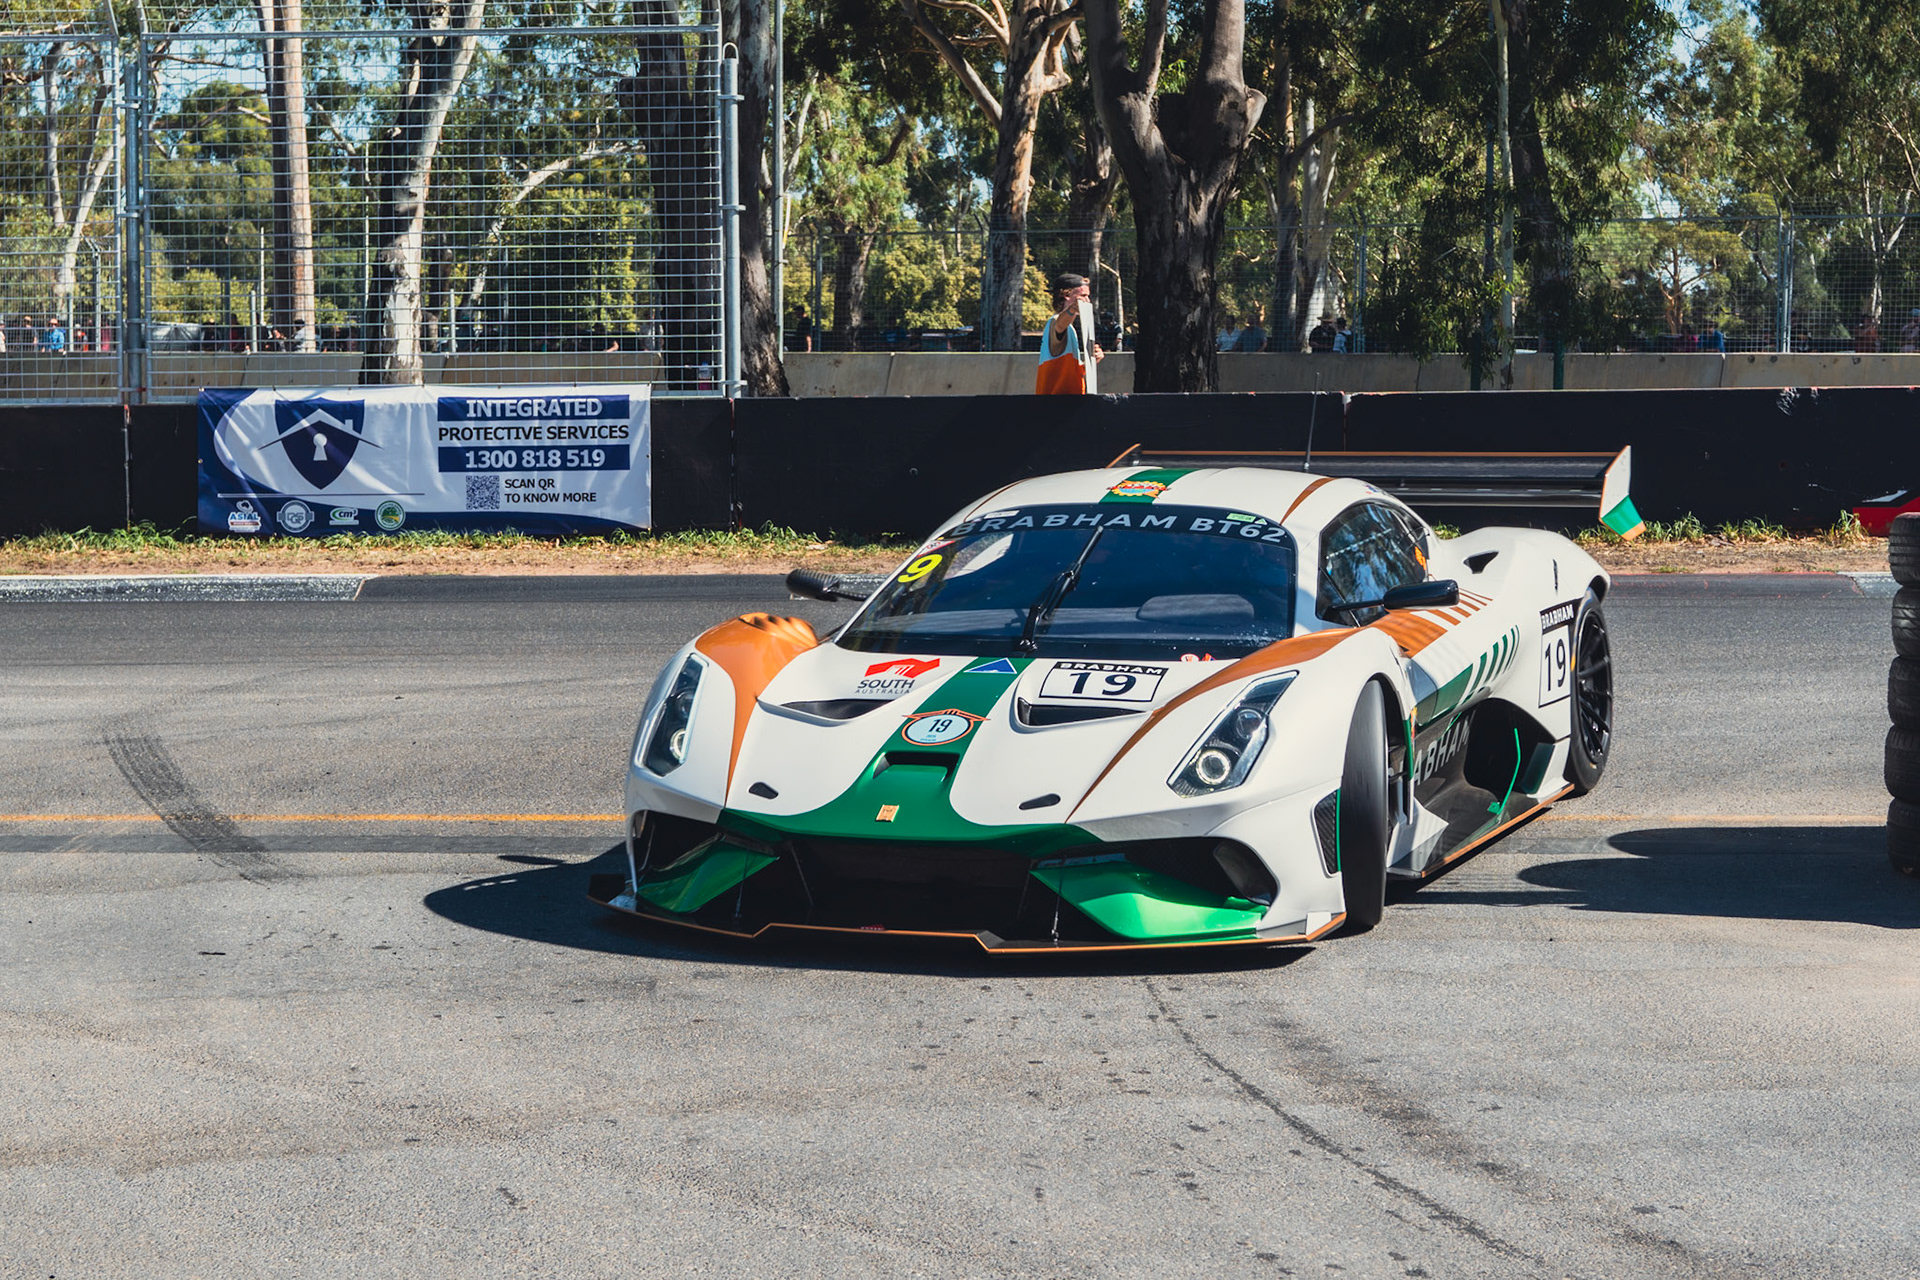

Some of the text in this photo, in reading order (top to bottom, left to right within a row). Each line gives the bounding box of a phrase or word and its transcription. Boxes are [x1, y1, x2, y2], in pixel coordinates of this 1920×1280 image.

[466, 398, 603, 418] INTEGRATED
[438, 424, 629, 441] PROTECTIVE SERVICES
[465, 448, 606, 469] 1300 818 519
[504, 478, 556, 490] SCAN QR
[504, 492, 597, 503] TO KNOW MORE
[951, 513, 1286, 543] BRABHAM BT62
[897, 553, 943, 583] 9
[1060, 662, 1163, 675] BRABHAM
[1544, 638, 1566, 692] 19
[857, 679, 915, 689] SOUTH
[1069, 672, 1137, 696] 19
[928, 718, 953, 733] 19
